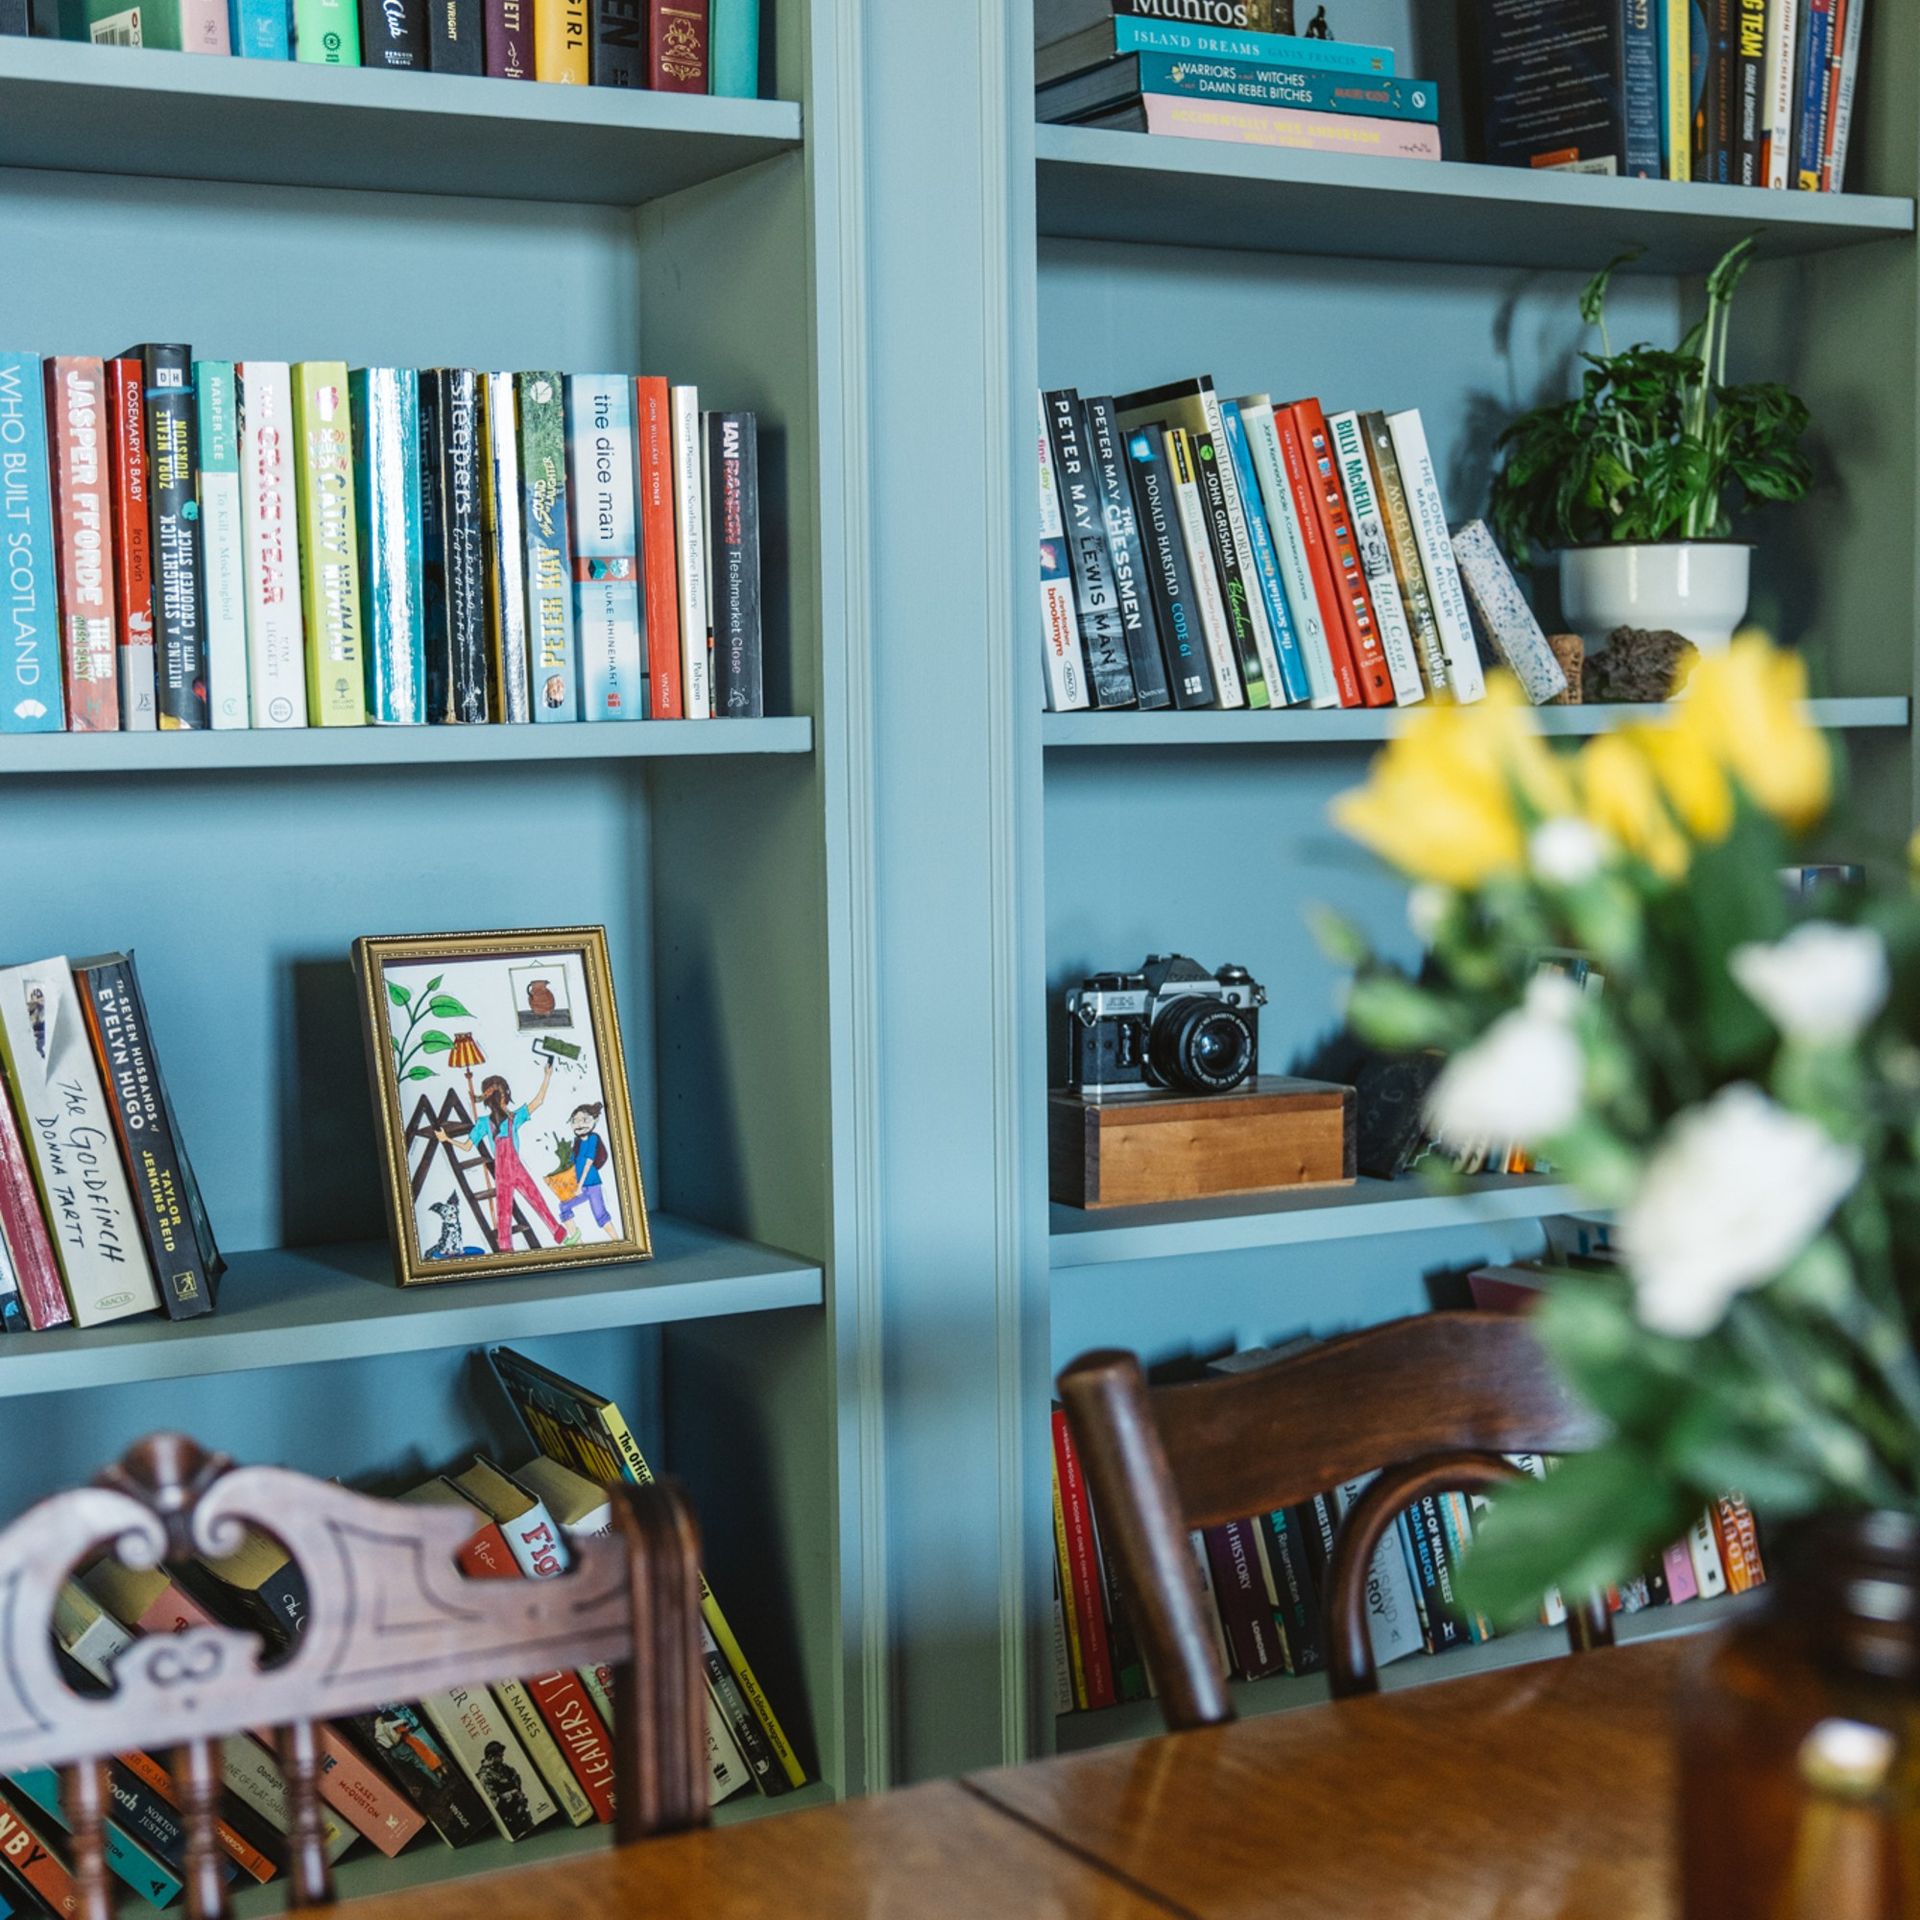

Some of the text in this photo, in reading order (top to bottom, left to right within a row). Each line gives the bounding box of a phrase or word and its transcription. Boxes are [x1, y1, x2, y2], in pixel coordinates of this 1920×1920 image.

[383, 0, 409, 40] Club
[447, 1, 458, 42] WRIGHT
[1132, 0, 1249, 27] Munros
[1134, 30, 1260, 56] ISLAND DREAMS
[1741, 14, 1764, 57] TEAM
[1178, 62, 1305, 86] WARRIORS WITCHES
[1200, 80, 1234, 95] DAMN
[1238, 86, 1267, 99] REBEL
[1270, 89, 1313, 103] BITCHES
[1778, 36, 1791, 114] LANCHESTER
[155, 410, 174, 489] ZORA NEALE
[174, 419, 188, 480] HURSTON
[210, 376, 224, 461] HARPER LEE
[450, 380, 471, 516] sleepers
[721, 421, 739, 458] IAN
[1093, 404, 1121, 501] PETER MAY
[67, 370, 103, 606] JASPER FFORDE
[127, 381, 145, 582] ROSEMARY'S BABY Ira Levin
[545, 455, 556, 507] LAUGHTER
[594, 394, 616, 542] the dice man
[1038, 437, 1052, 492] fine day
[1055, 400, 1093, 530] PETER MAY
[1206, 394, 1250, 571] SCOTTISH GHOST STORIES
[1263, 424, 1290, 513] John Kennedy Toole
[1287, 446, 1299, 480] FLEMING
[1296, 484, 1307, 513] CASINO
[1335, 418, 1357, 456] BILLY
[1346, 457, 1374, 519] McNEILL
[0, 366, 40, 686] WHO BUILT SCOTLAND
[316, 472, 349, 556] CATHY
[532, 478, 548, 523] SOUND
[1120, 506, 1134, 537] THE
[1387, 482, 1412, 536] FLOW
[216, 491, 232, 622] To Kill Mockingbird
[261, 527, 284, 605] YEAR
[649, 397, 671, 709] JOHN WILLIAMS STONER VINTAGE
[1103, 504, 1142, 631] CHESSMEN
[1144, 474, 1193, 659] DONALD HARSTAD CODE 61
[1206, 471, 1249, 640] JOHN GRISHAM Bleachers
[1251, 515, 1293, 650] the Scottish book
[1401, 537, 1423, 593] SCAPA
[1415, 488, 1454, 619] MADELINE MILLER
[1419, 456, 1472, 643] THE SONG OF ACHILLES
[162, 513, 182, 689] HITTING A STRAIGHT LICK
[180, 529, 196, 673] WITH A CROOKED STICK
[321, 563, 355, 662] NEWMAN
[536, 544, 566, 668] PETER KAY
[729, 550, 744, 634] Fleshmarket
[1047, 587, 1063, 657] brookmyre
[1057, 595, 1071, 647] christopher
[1080, 537, 1117, 666] LEWIS MAN
[1379, 582, 1408, 672] Hail Cesar
[1414, 592, 1426, 609] at
[88, 617, 110, 651] THE
[266, 621, 279, 678] LIGGETT
[605, 584, 618, 687] LUKE RHINEHART
[732, 637, 743, 675] Close
[693, 661, 703, 701] Polygon
[98, 988, 145, 1130] EVELYN HUGO
[119, 995, 157, 1126] SEVEN HUSBANDS
[34, 1115, 85, 1250] DONNA TARTT
[57, 1079, 126, 1265] The GOLDFINCH
[142, 1149, 176, 1253] JENKINS REID
[159, 1168, 182, 1226] TAYLOR
[617, 1430, 632, 1453] The
[1062, 1425, 1077, 1489] VIRGINIA WOOLF
[1228, 1530, 1252, 1591] HISTORY
[1320, 1525, 1331, 1538] TO
[1417, 1541, 1436, 1588] BELFORT
[1427, 1517, 1454, 1604] OF WALL STREET
[1277, 1532, 1301, 1603] Resurrection
[282, 1593, 298, 1618] The
[1250, 1619, 1269, 1666] LOMOND
[708, 1658, 740, 1708] KATHARINE
[738, 1669, 788, 1759] London Editions Magazines
[459, 1712, 481, 1741] KYLE
[467, 1702, 493, 1737] CHRIS
[510, 1697, 542, 1740] NAMES
[554, 1699, 614, 1788] LEAVERS
[144, 1804, 180, 1838] NORTON
[337, 1781, 381, 1820] McQUISTON
[353, 1779, 379, 1805] CASEY
[449, 1802, 471, 1829] VINTAGE
[137, 1814, 170, 1844] JUSTER
